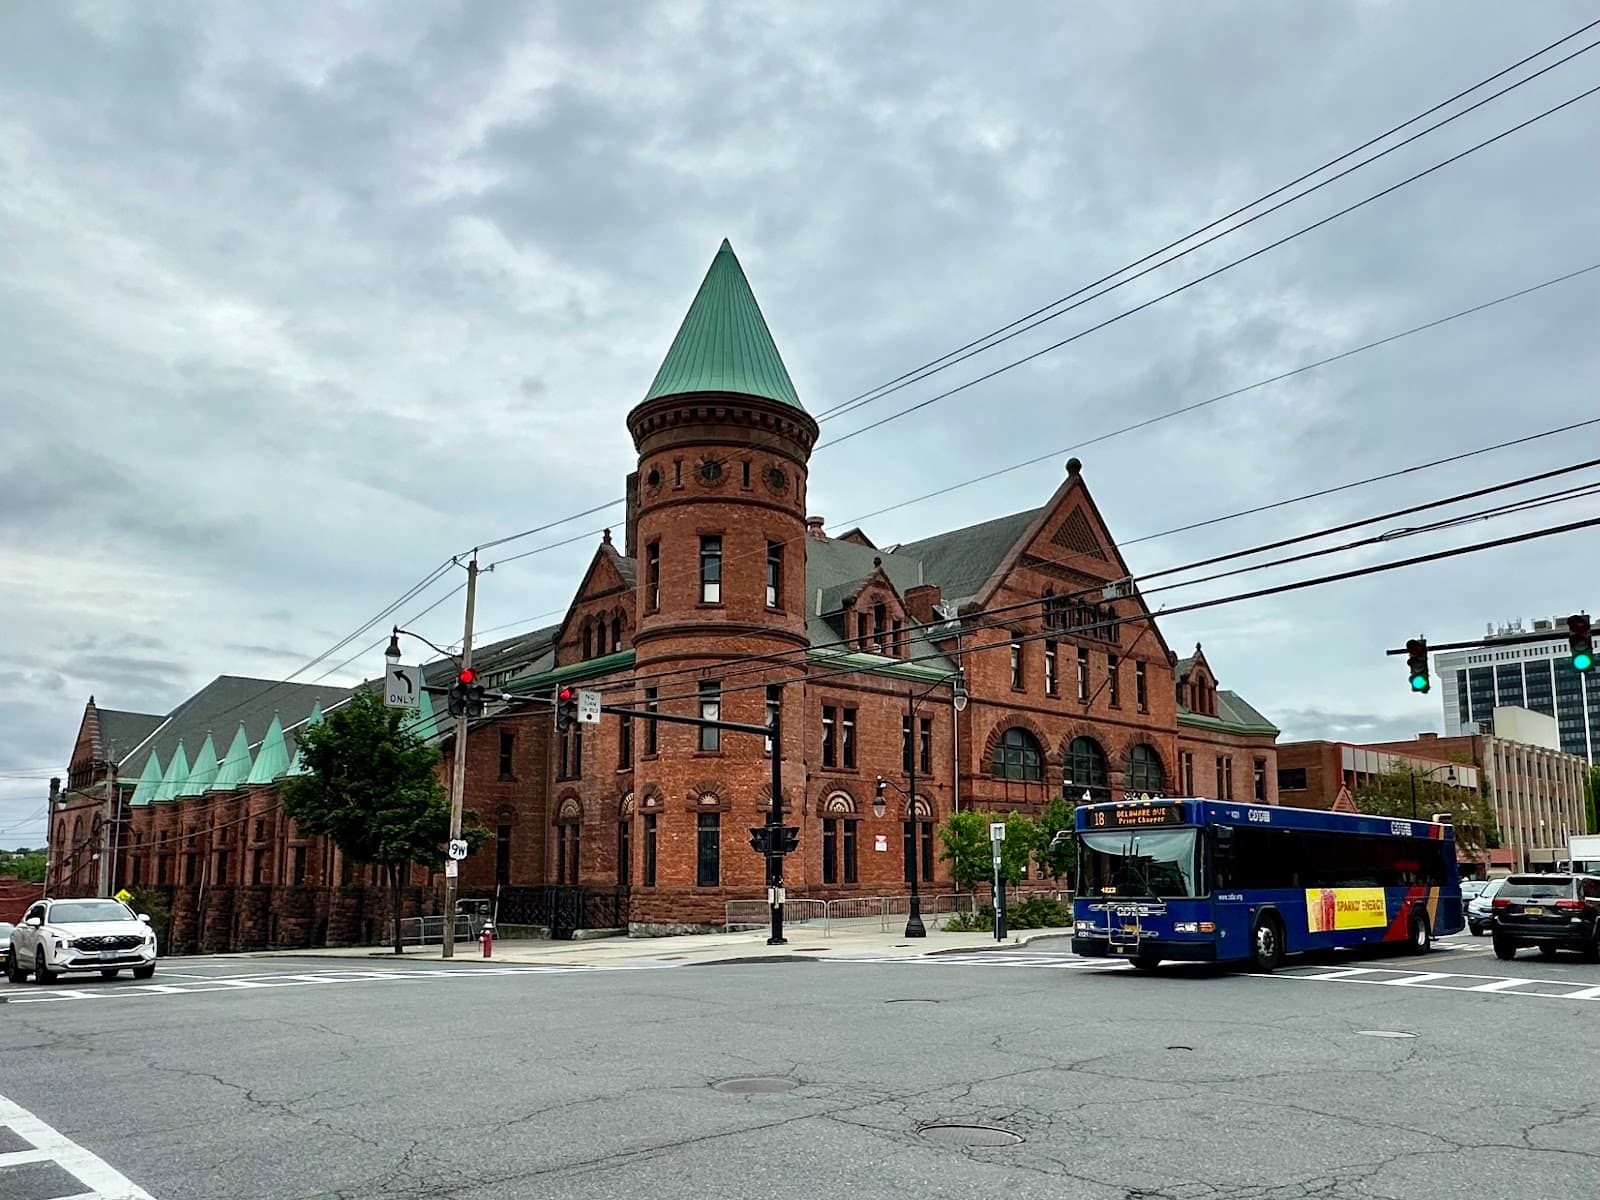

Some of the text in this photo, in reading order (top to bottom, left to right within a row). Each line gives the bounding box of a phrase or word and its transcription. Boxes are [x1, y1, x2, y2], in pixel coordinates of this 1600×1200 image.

[390, 694, 415, 704] ONLY
[1093, 812, 1105, 826] 18
[1116, 810, 1151, 818] DELAWARE
[451, 843, 466, 856] 9W
